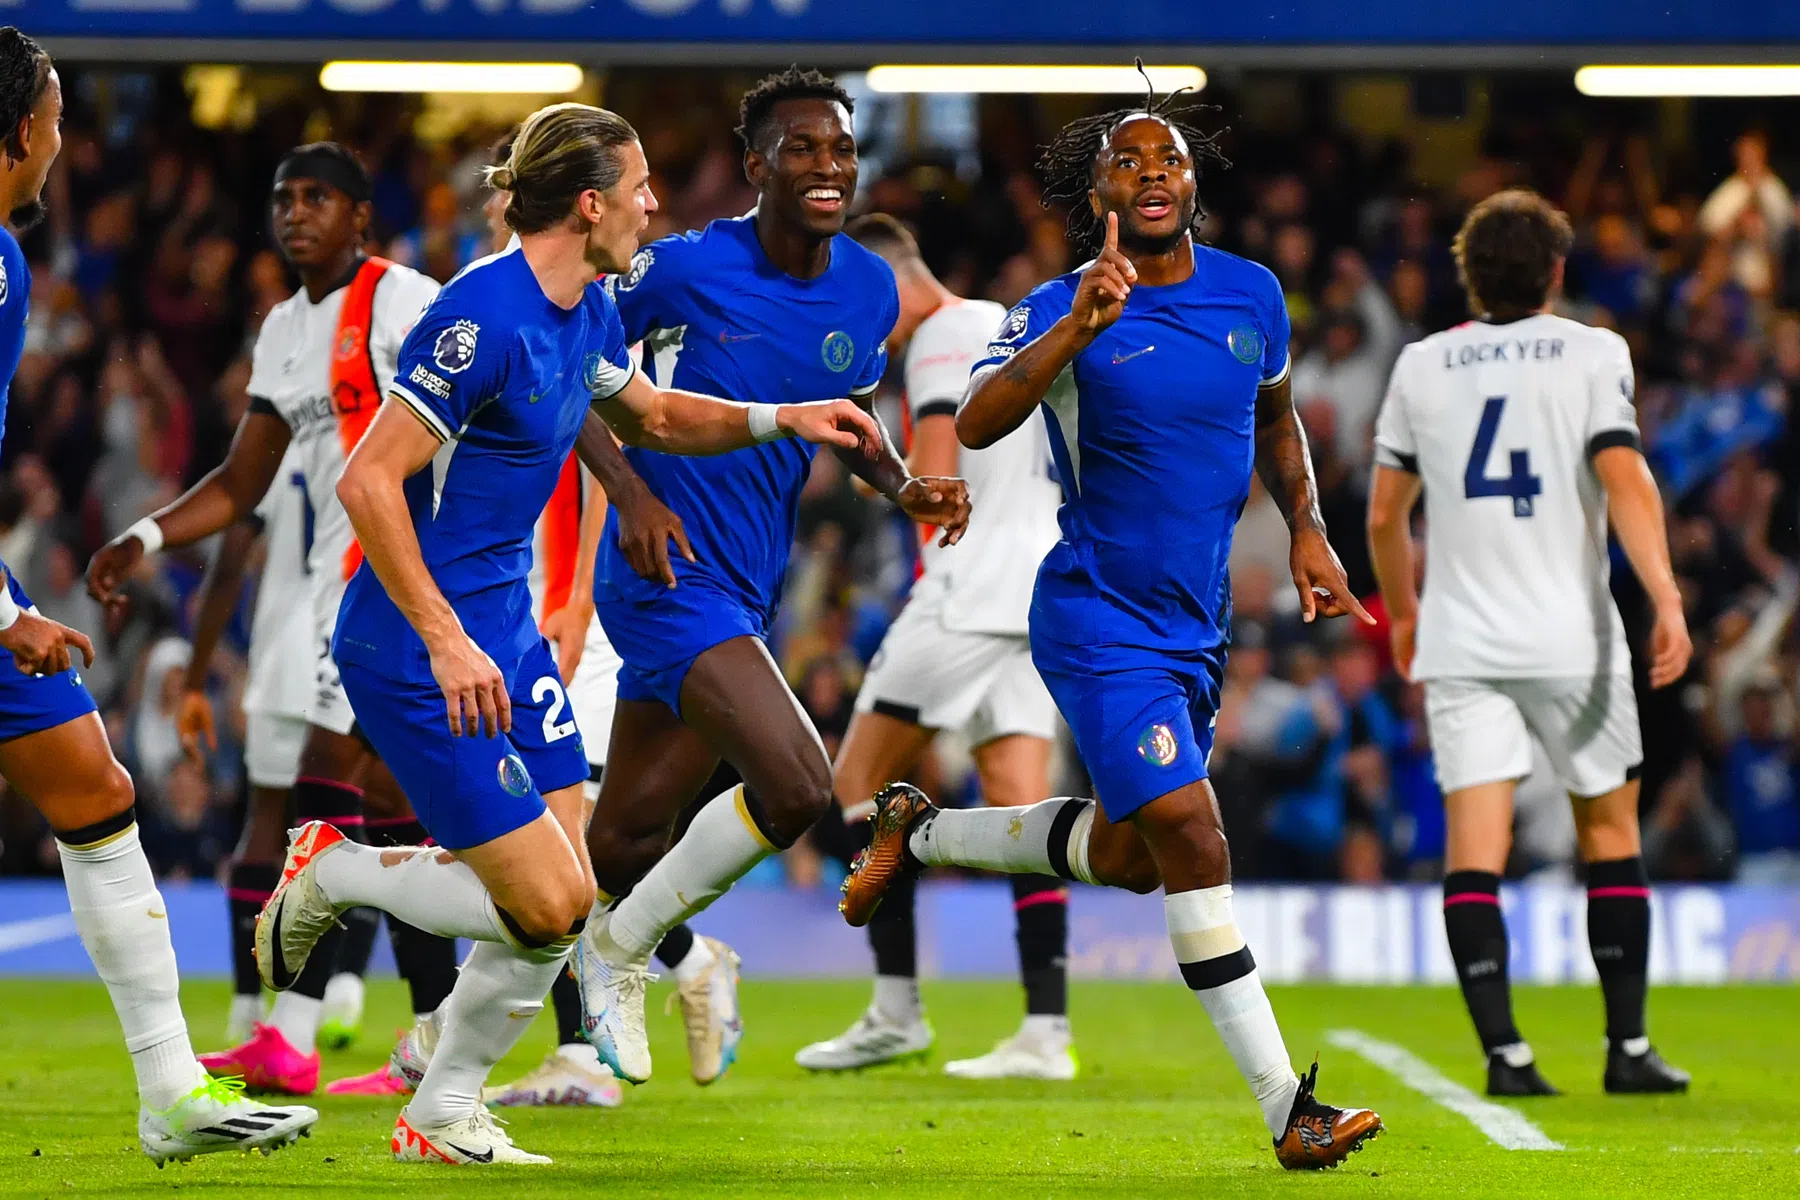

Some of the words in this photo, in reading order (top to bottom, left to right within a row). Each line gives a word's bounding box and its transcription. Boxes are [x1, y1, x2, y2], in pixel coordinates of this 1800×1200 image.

[412, 363, 429, 378] No
[426, 372, 452, 391] room
[1444, 338, 1566, 369] LOCKYER
[1464, 396, 1543, 517] 4
[531, 675, 577, 744] 2
